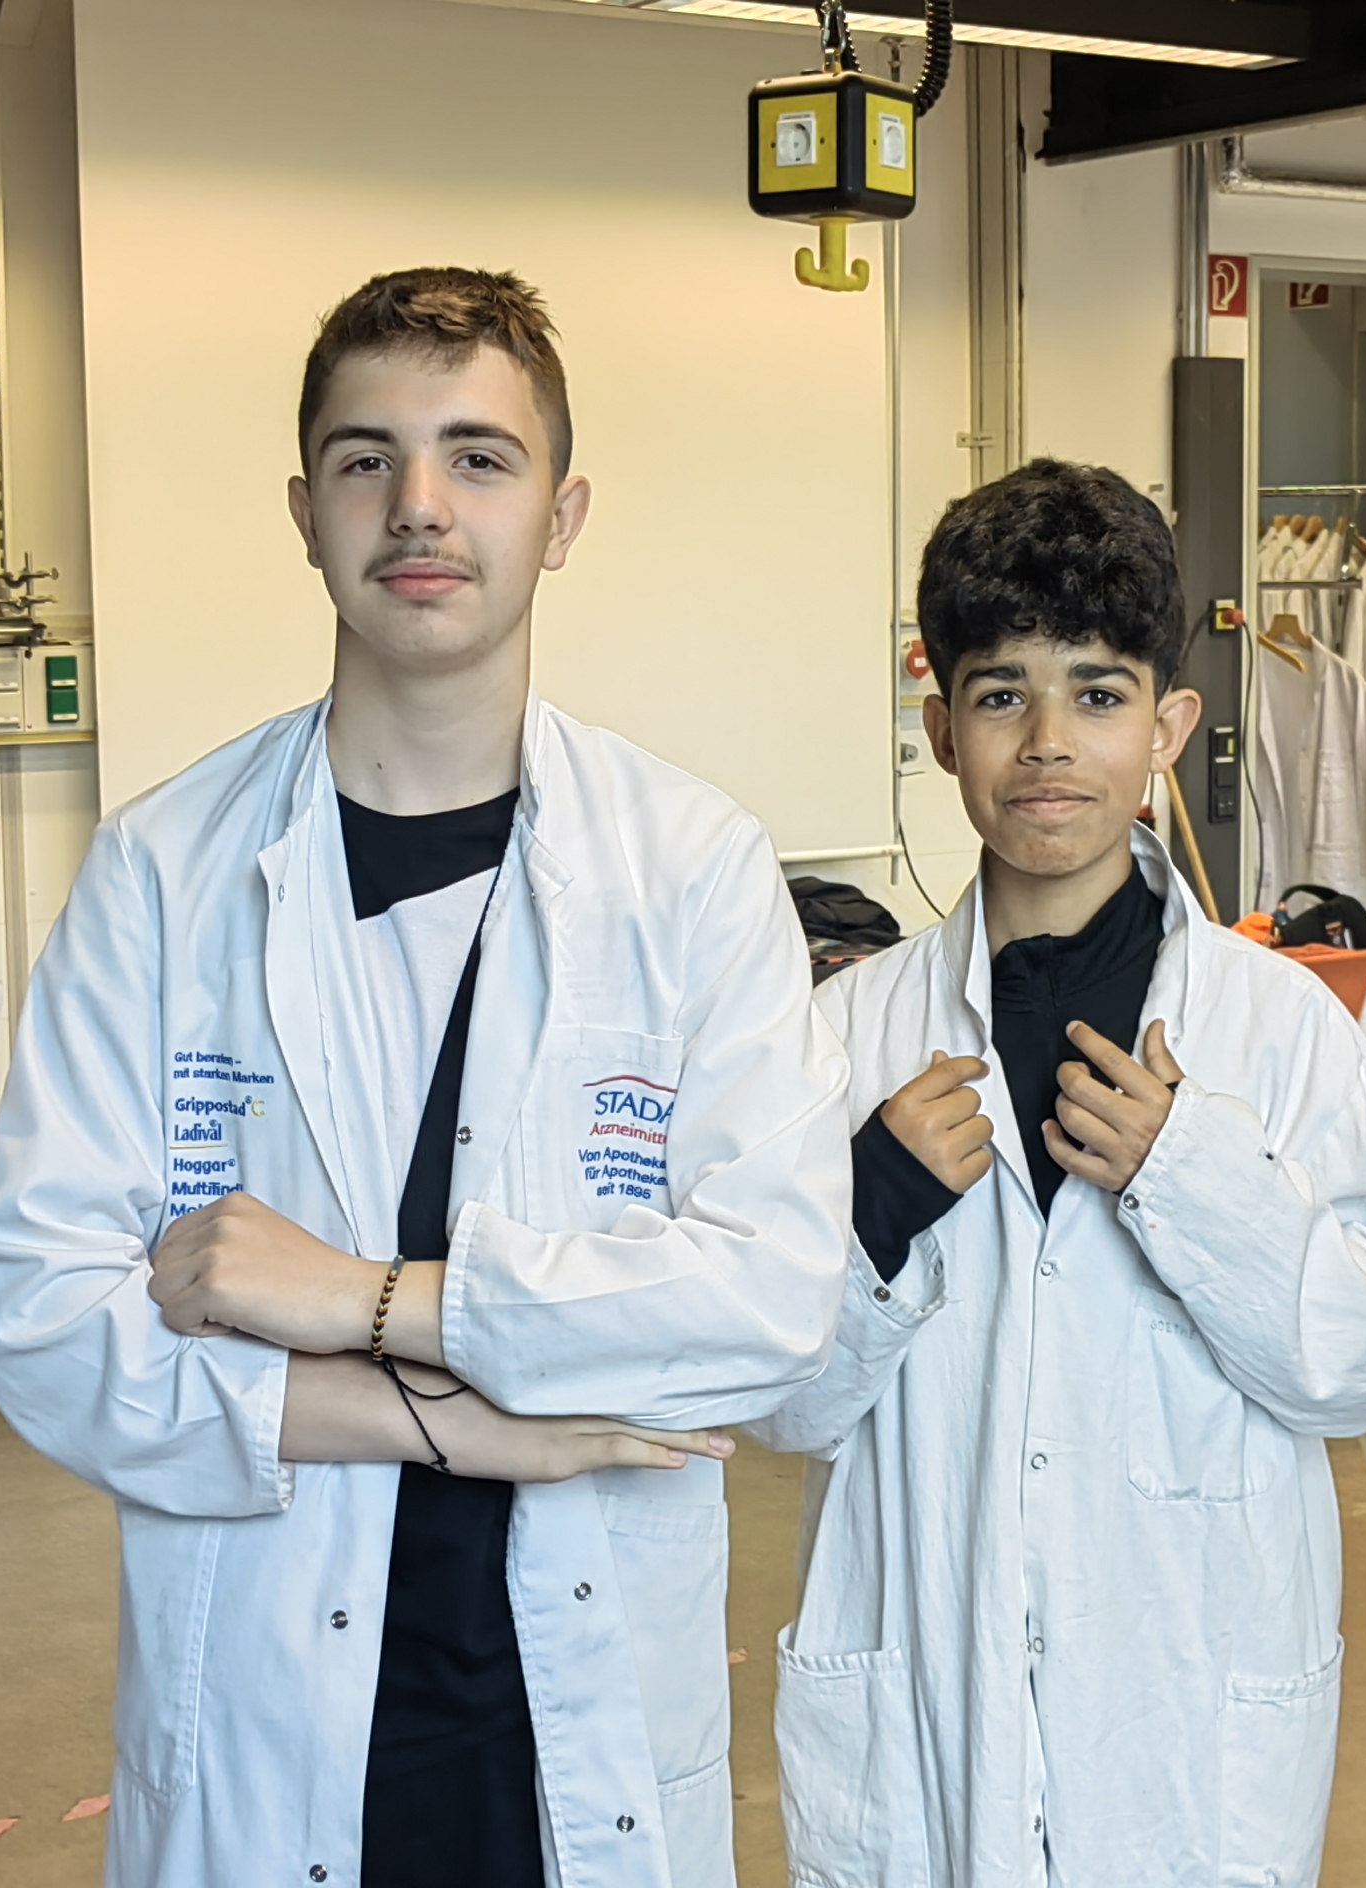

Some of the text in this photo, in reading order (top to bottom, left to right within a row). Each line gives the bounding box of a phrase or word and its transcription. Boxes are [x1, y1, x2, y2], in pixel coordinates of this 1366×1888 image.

[174, 1051, 193, 1063] Gut
[173, 1067, 190, 1079] mit
[232, 1070, 275, 1084] Marken
[594, 1091, 675, 1124] STADA
[578, 1148, 601, 1163] Von
[585, 1166, 601, 1181] für
[596, 1182, 615, 1197] seit
